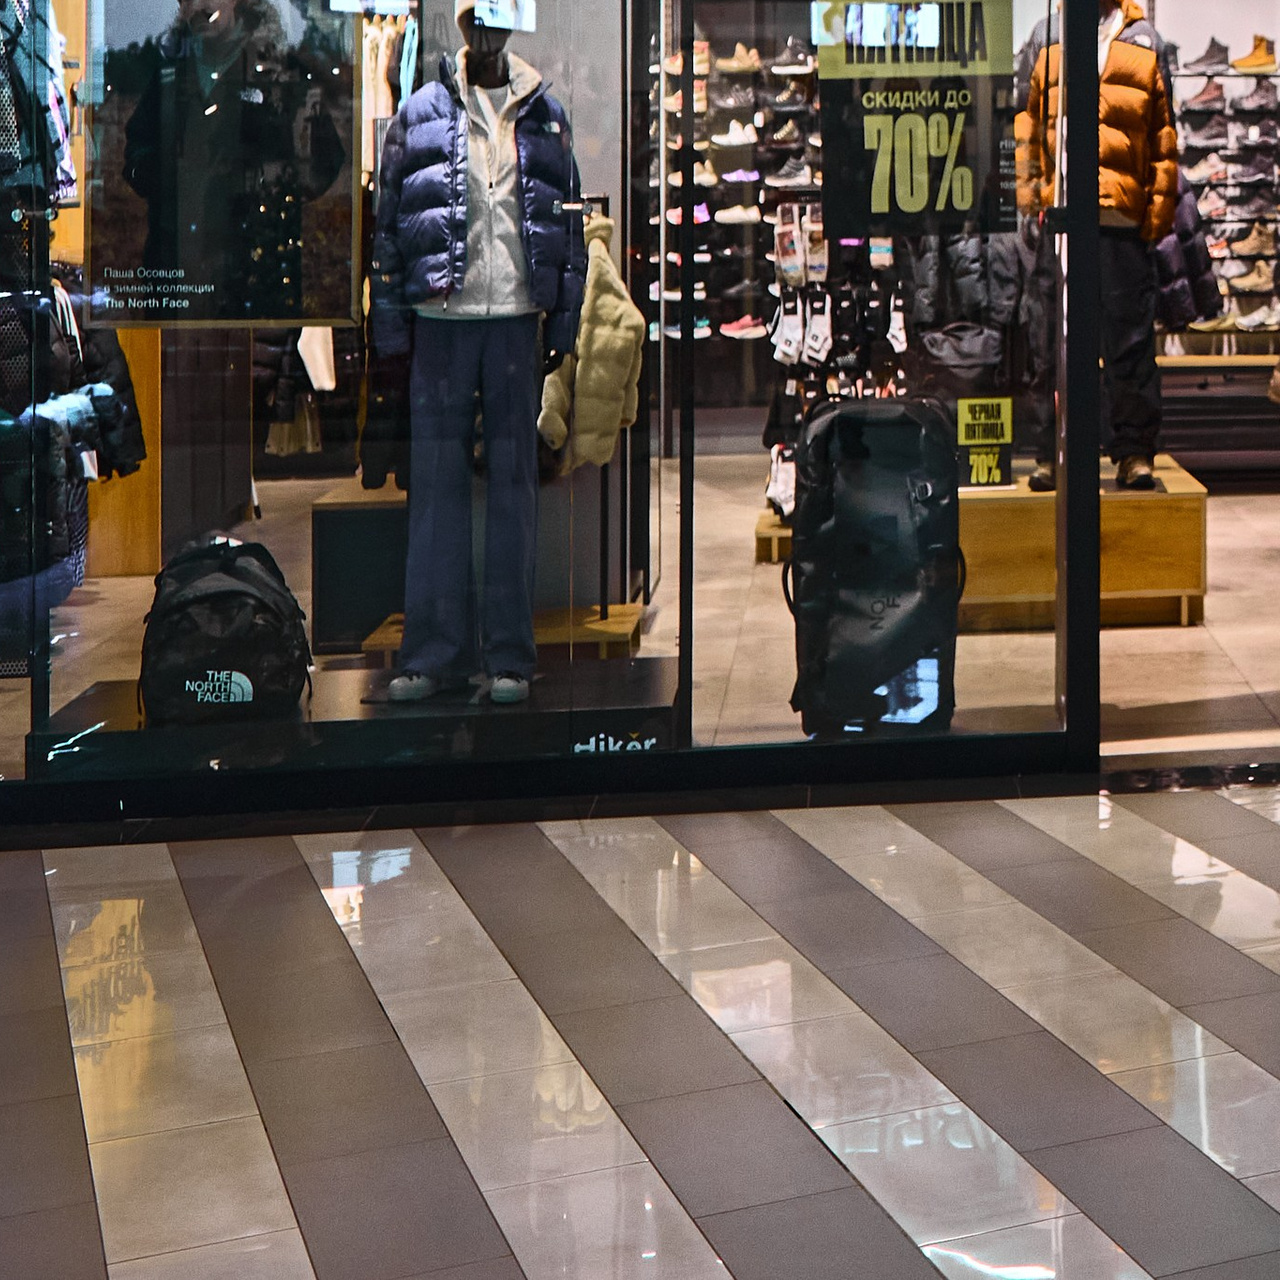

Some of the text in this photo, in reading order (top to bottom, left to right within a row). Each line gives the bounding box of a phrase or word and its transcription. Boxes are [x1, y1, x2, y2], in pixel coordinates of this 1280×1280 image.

[863, 112, 974, 213] 70%
[104, 267, 185, 279] Паша Осовцов
[114, 282, 154, 293] зимней
[157, 284, 215, 294] коллекции
[104, 297, 190, 308] The North Face
[969, 454, 1002, 484] 70%
[206, 670, 231, 682] THE
[185, 680, 230, 692] NORTH
[197, 691, 229, 703] FACE
